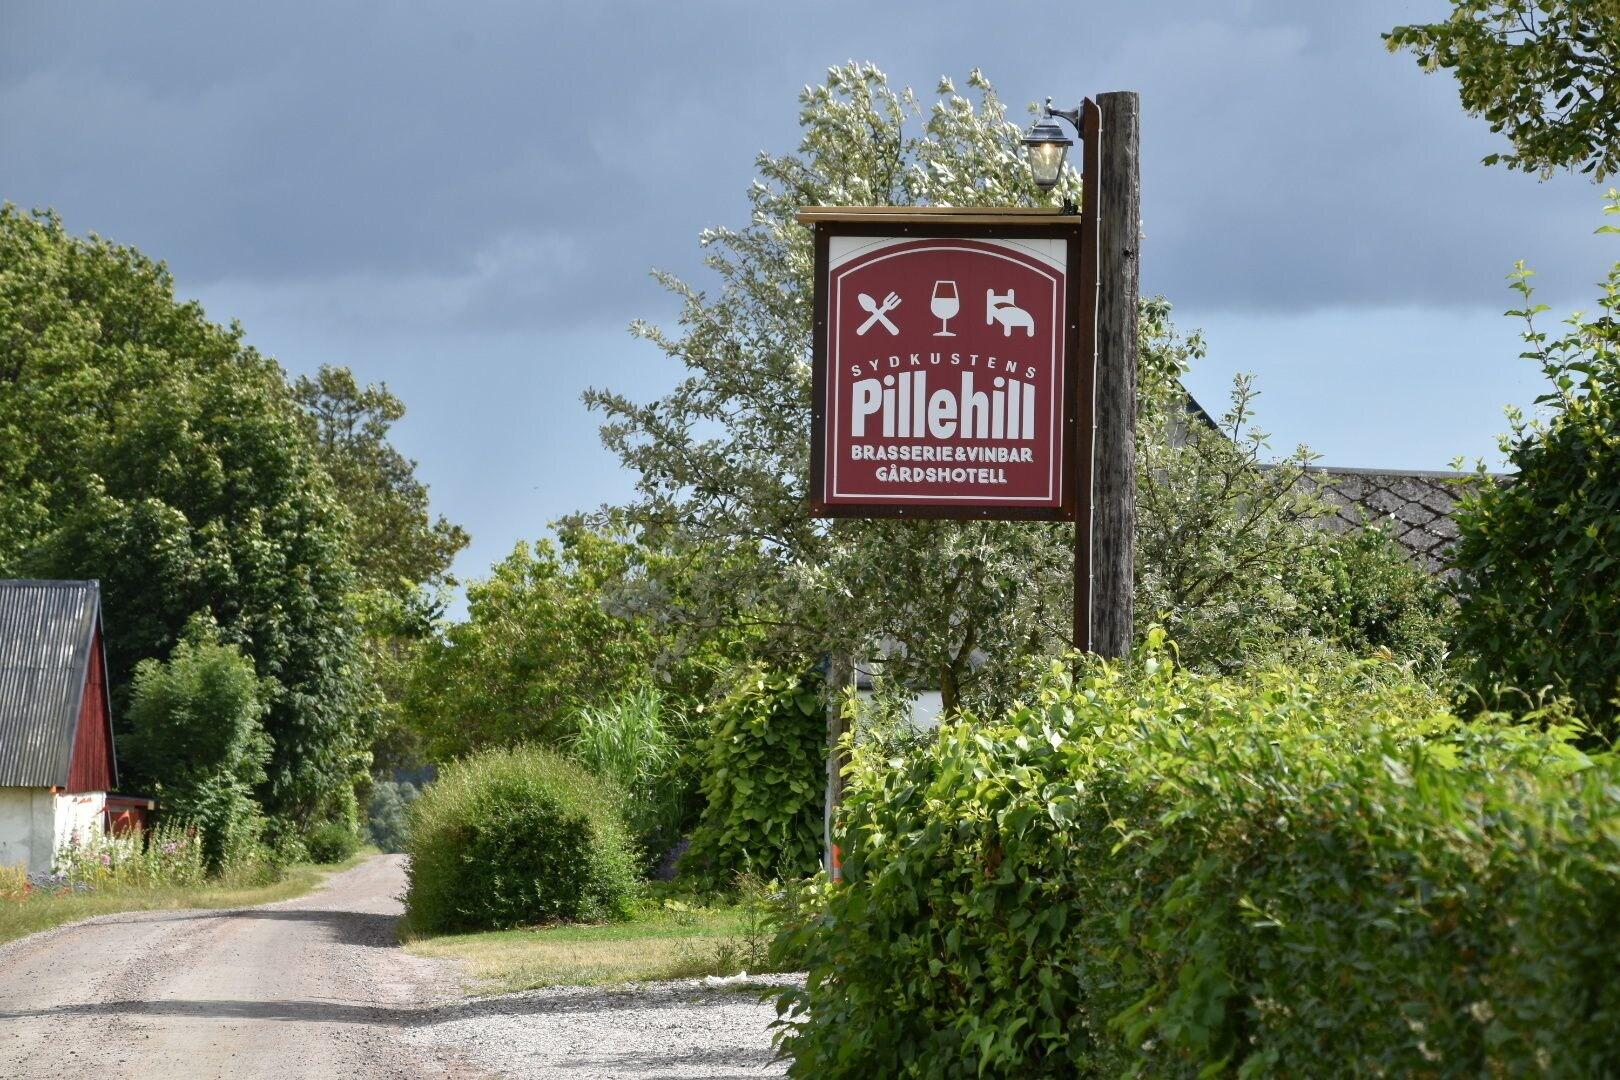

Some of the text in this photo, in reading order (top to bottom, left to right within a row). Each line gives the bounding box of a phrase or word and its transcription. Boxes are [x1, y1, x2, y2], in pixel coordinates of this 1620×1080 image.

[851, 352, 1037, 379] SYDKUSTENS
[851, 370, 1036, 440] Pillehill
[875, 463, 1008, 484] GÅRDSHOTELL
